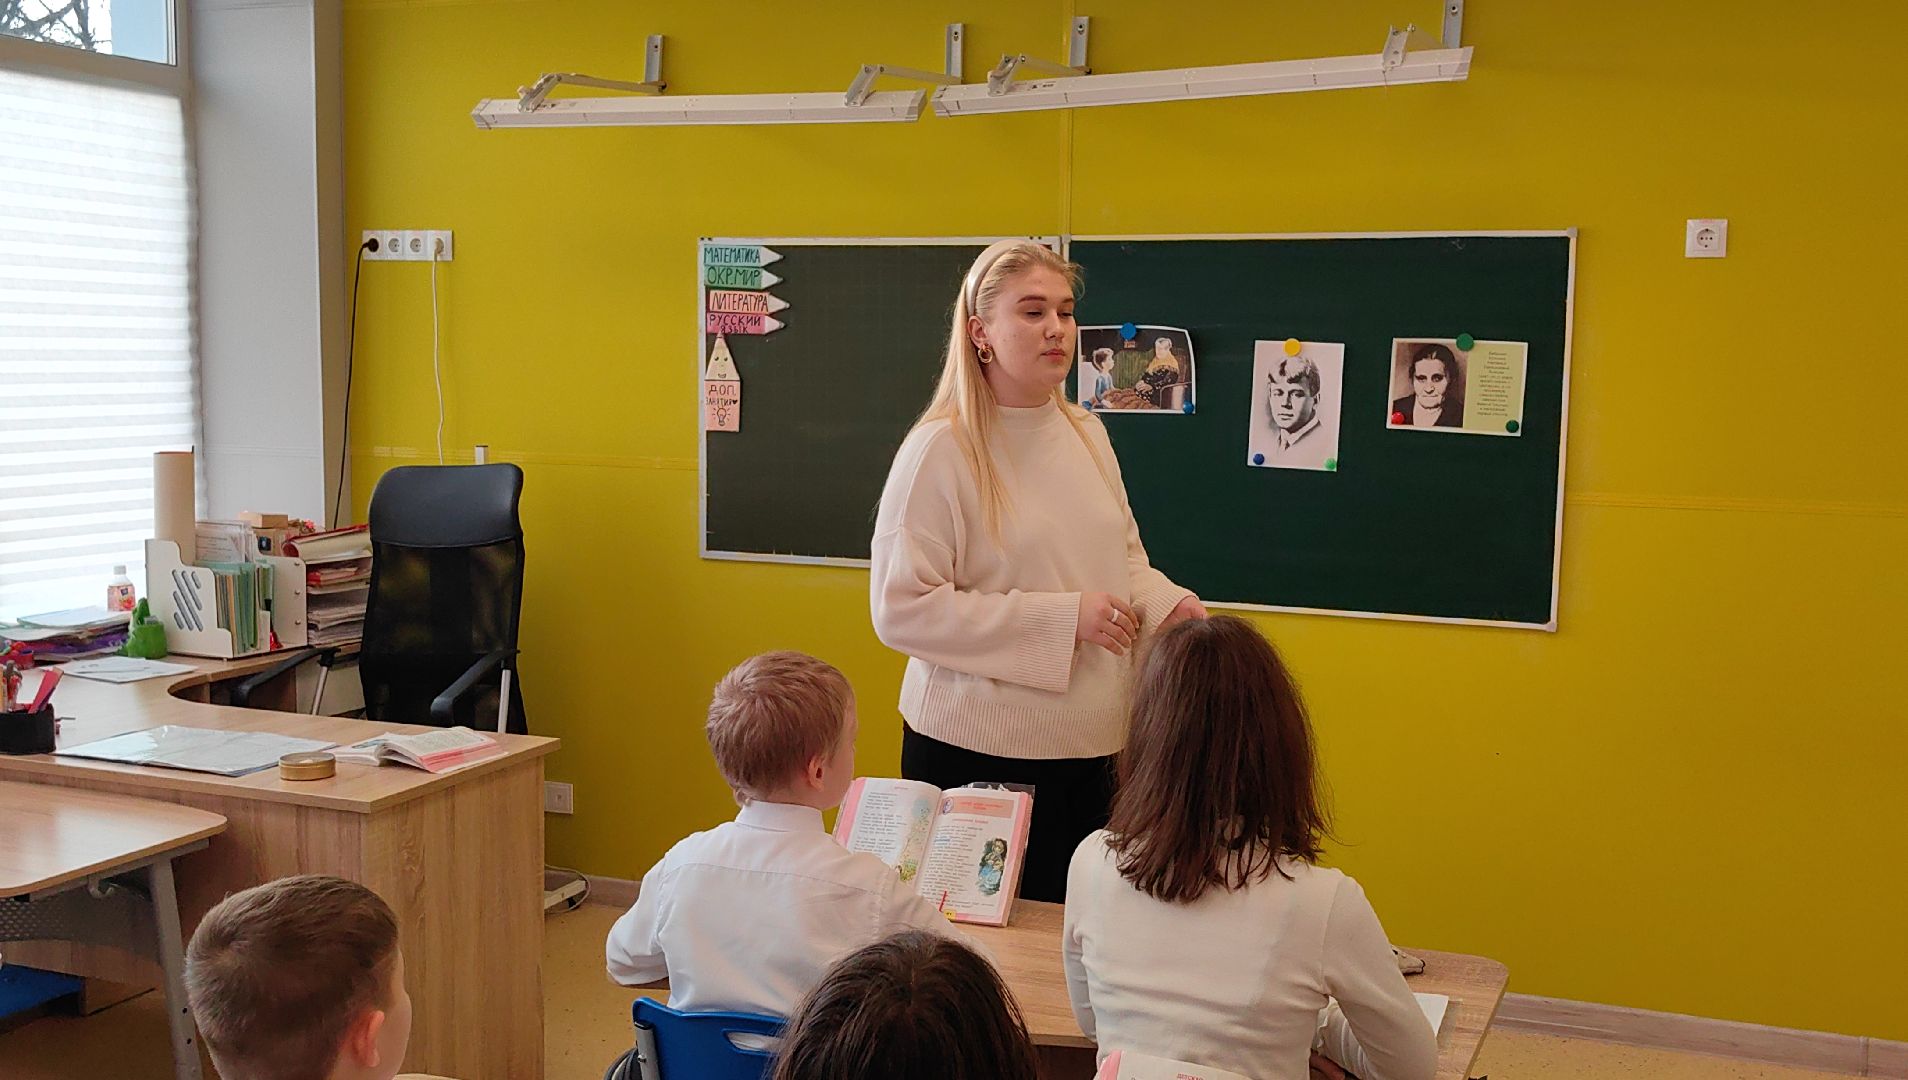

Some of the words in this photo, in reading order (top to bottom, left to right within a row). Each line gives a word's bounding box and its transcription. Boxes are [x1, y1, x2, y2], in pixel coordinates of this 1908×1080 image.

[704, 248, 761, 263] МАТЕМАТИКА
[712, 292, 769, 312] ЛИТЕРАТУРА
[709, 314, 761, 327] РУССКИЙ
[720, 326, 748, 334] ЯЗЫК
